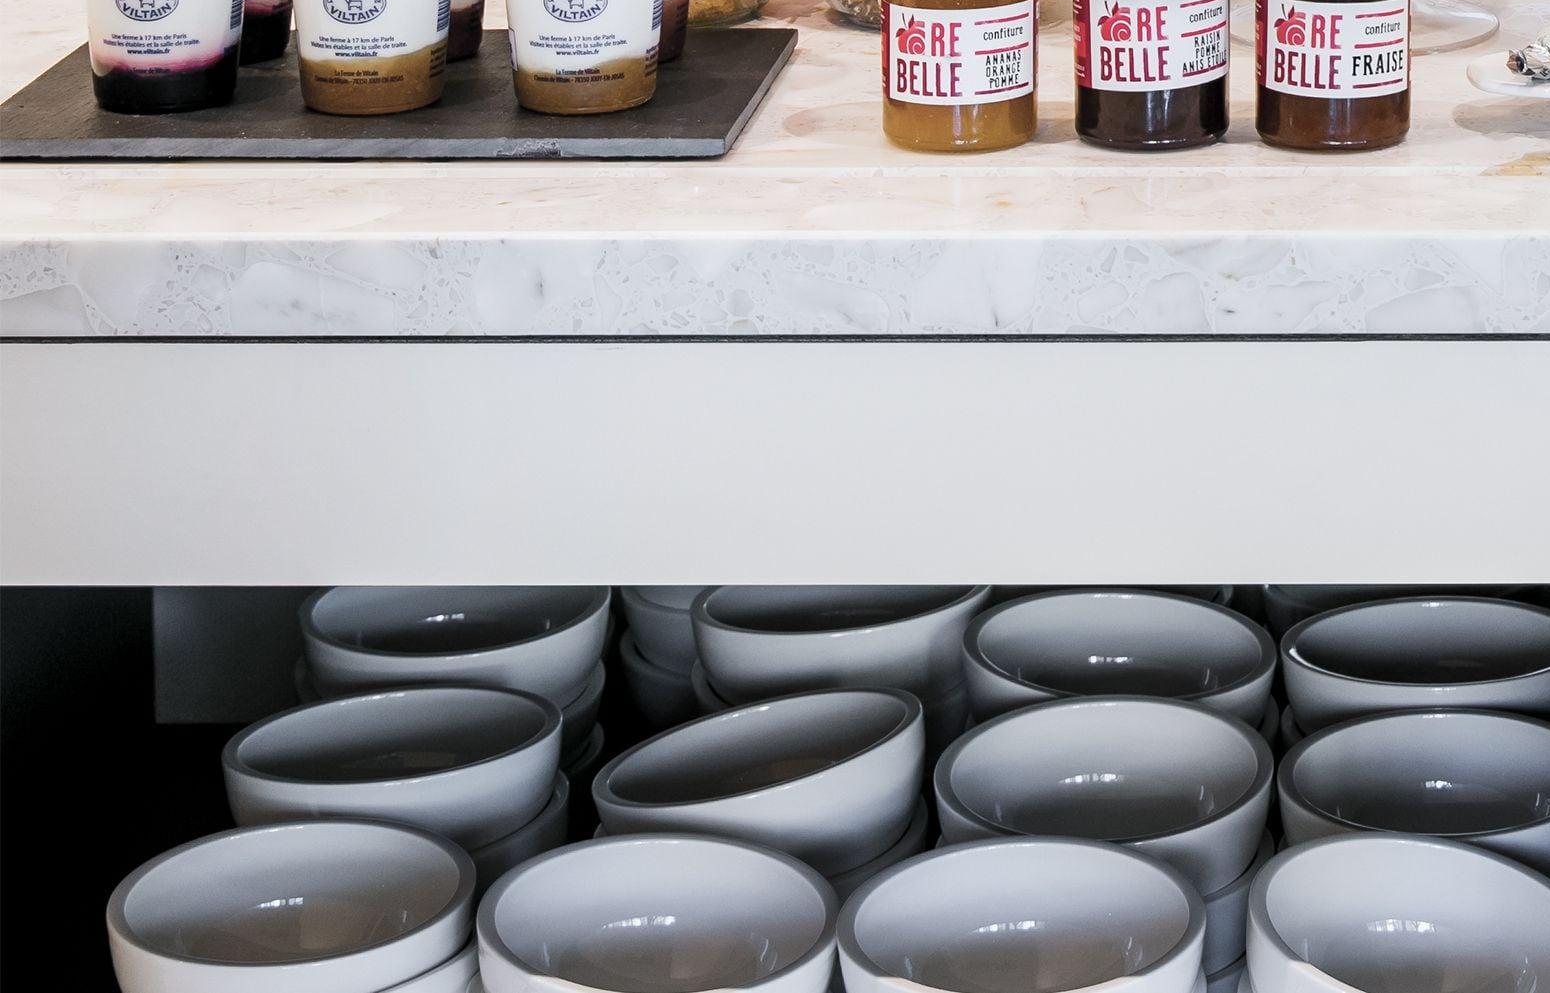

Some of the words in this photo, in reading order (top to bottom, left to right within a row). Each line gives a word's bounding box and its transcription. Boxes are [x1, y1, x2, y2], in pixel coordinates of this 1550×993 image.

[122, 3, 172, 19] VILTAIN
[330, 6, 379, 21] VILTAIN
[551, 4, 601, 20] VILTAIN
[1189, 6, 1223, 23] confiture
[983, 25, 1024, 41] confiture
[1365, 21, 1401, 35] confiture
[1194, 30, 1221, 47] RAISIN
[985, 50, 1022, 66] ANANAS
[1195, 42, 1220, 59] POMME
[985, 62, 1021, 78] ORANGE
[1100, 46, 1170, 82] BELLE
[1182, 58, 1204, 73] ANIS
[1274, 48, 1342, 89] BELLE
[1352, 50, 1404, 76] FRAISE
[896, 58, 963, 97] BELLE
[989, 74, 1019, 88] POMME
